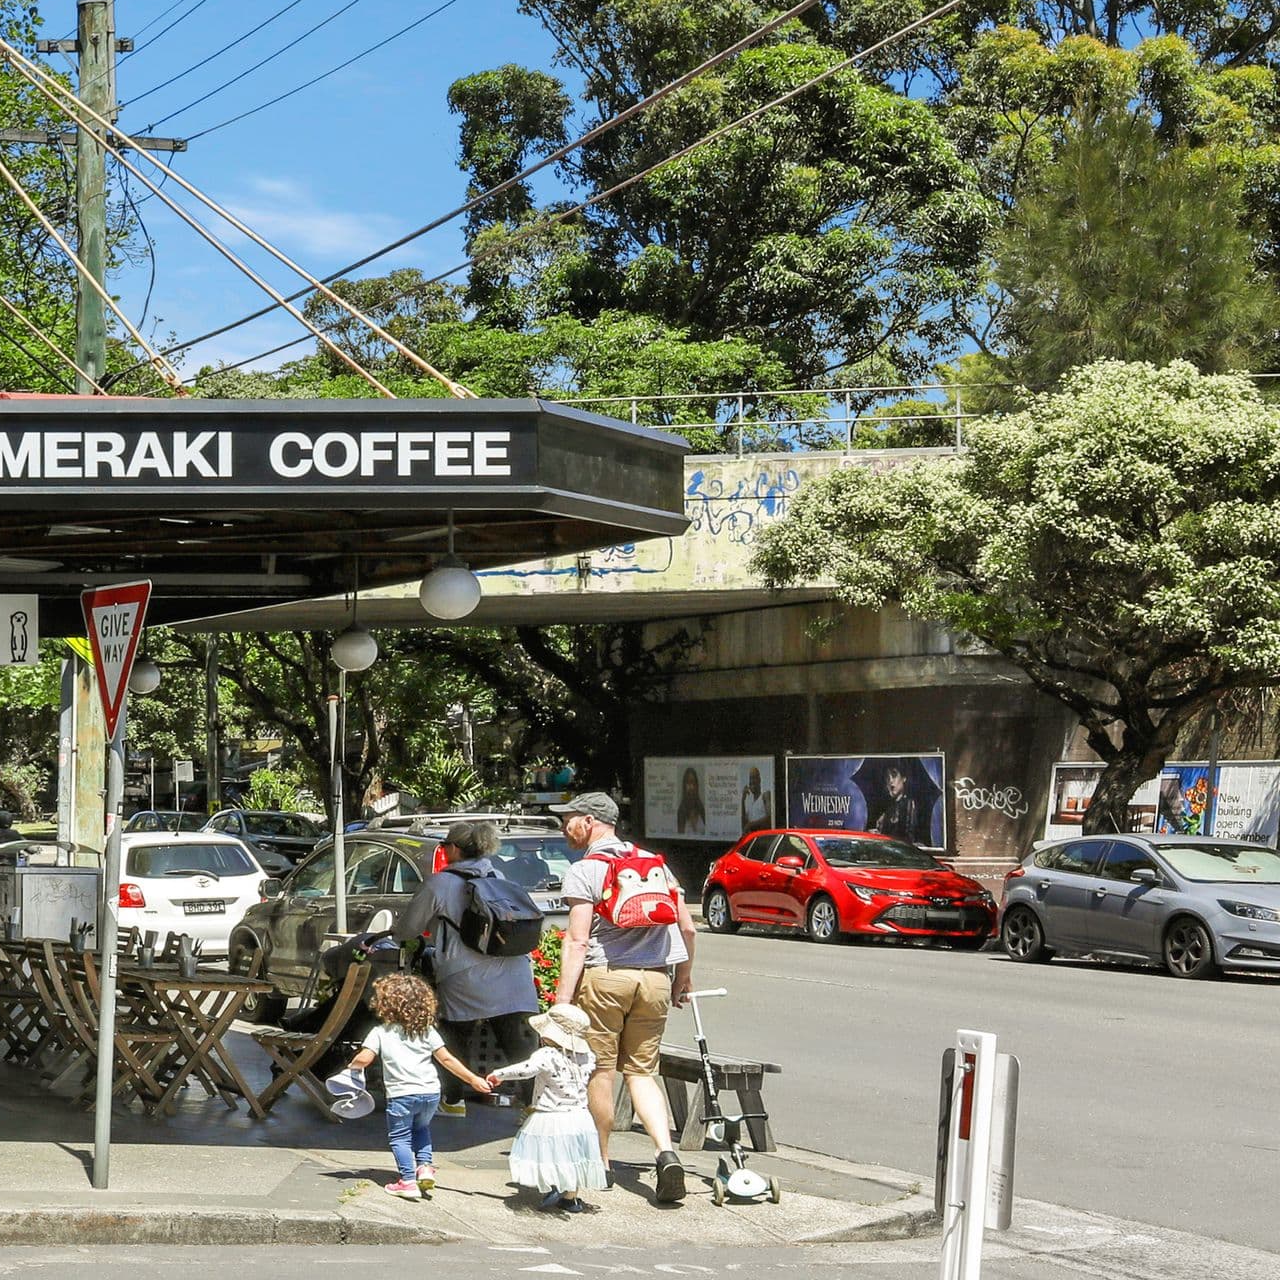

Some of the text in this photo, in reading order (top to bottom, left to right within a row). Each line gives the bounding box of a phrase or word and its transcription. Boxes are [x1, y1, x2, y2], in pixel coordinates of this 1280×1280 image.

[268, 431, 512, 478] COFFEE
[100, 612, 130, 638] GIVE
[103, 642, 125, 664] WAY
[801, 792, 851, 816] WEDNESDAY
[1219, 793, 1240, 803] New
[1217, 806, 1252, 818] building
[1216, 820, 1243, 829] opens
[1223, 831, 1270, 842] December
